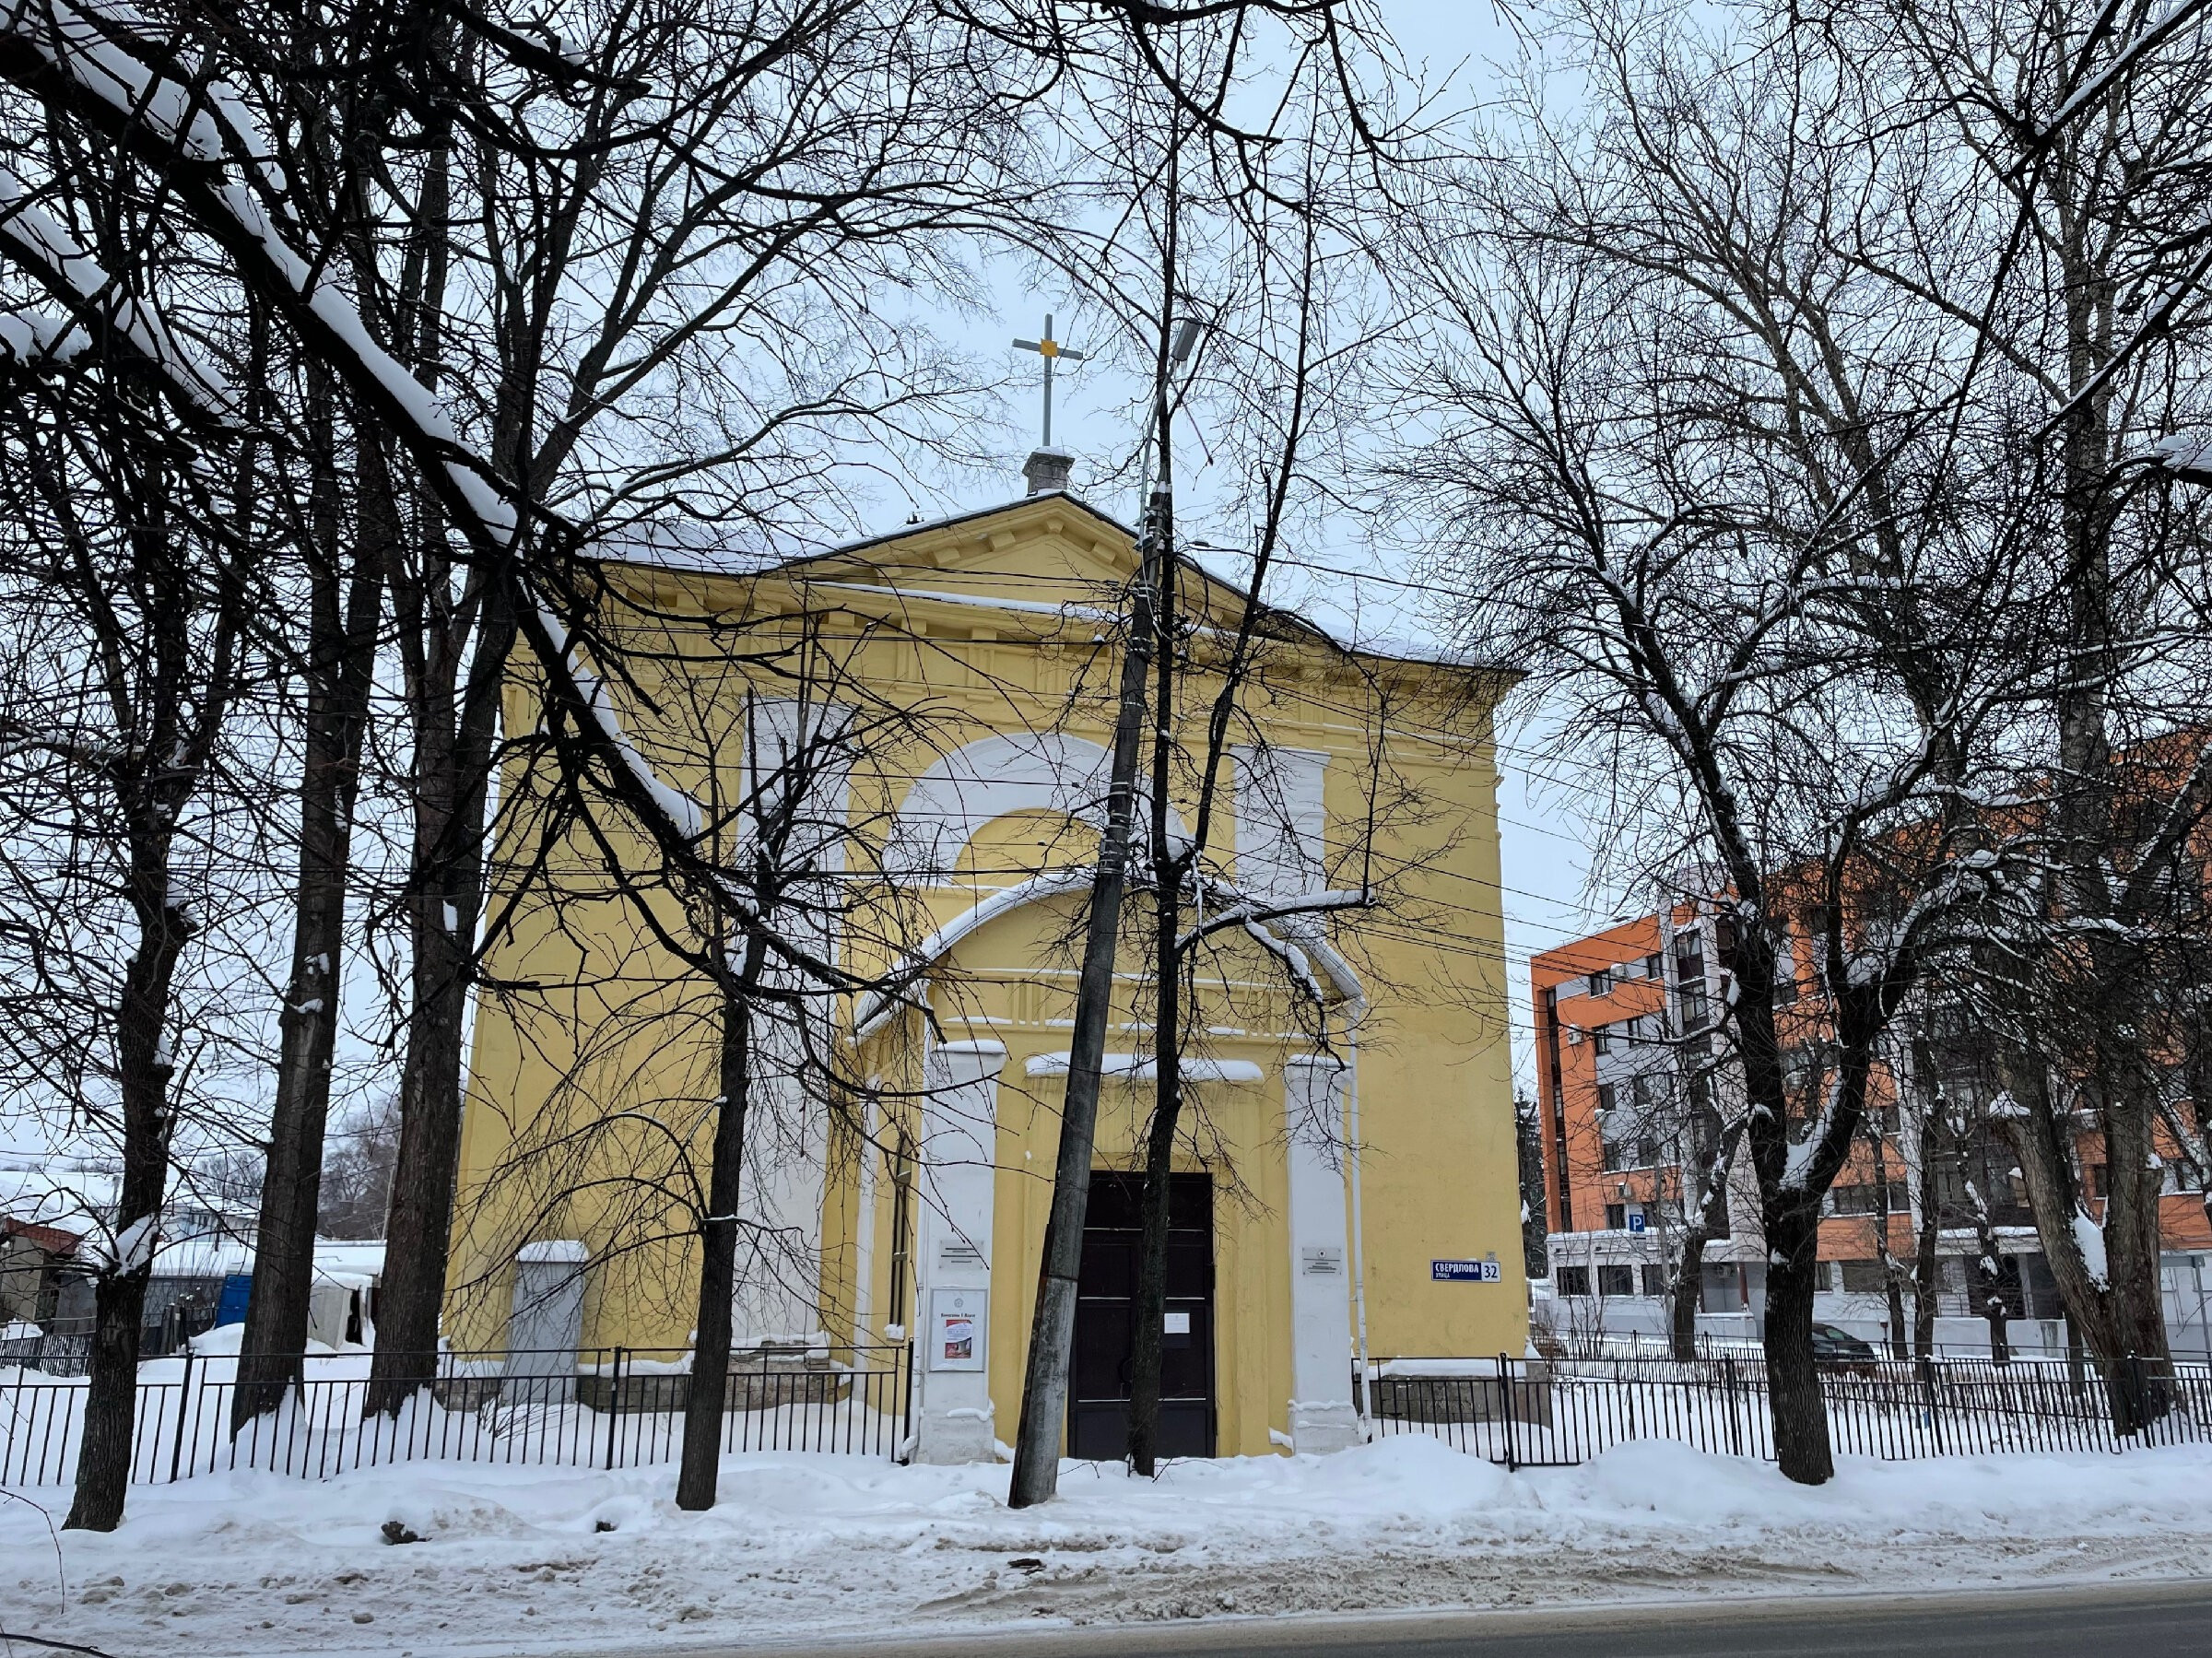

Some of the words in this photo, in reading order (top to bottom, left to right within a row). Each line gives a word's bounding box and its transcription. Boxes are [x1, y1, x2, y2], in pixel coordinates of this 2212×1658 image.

[1633, 1217, 1641, 1230] P
[1435, 1263, 1479, 1273] СВЕРДЛОВА
[1484, 1265, 1498, 1278] 32
